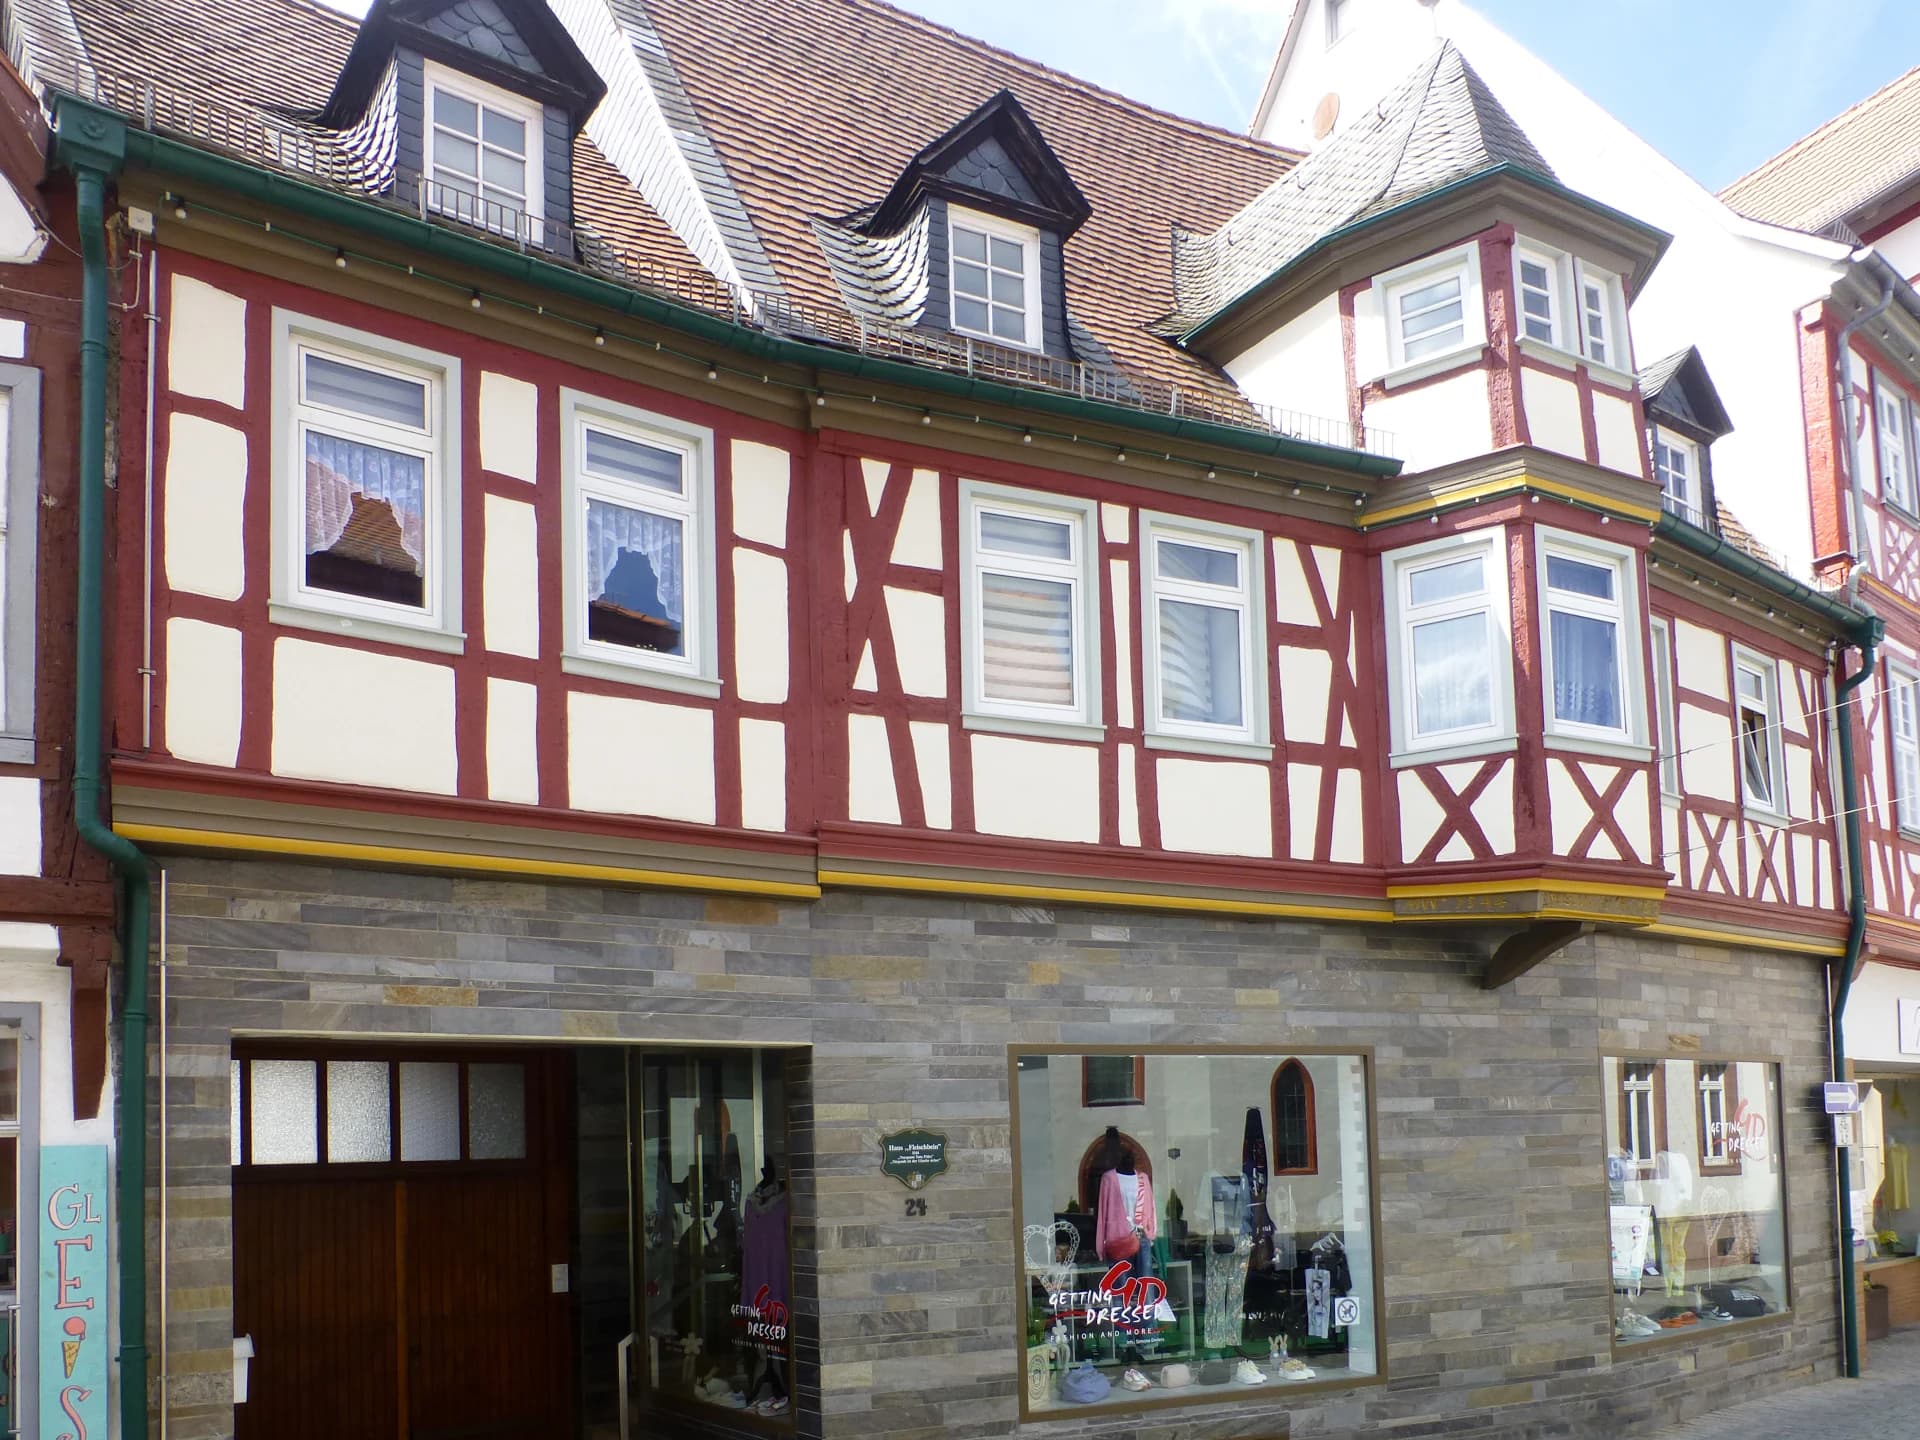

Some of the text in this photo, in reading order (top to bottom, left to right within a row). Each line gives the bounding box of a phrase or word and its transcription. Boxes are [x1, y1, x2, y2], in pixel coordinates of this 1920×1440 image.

[905, 1198, 927, 1216] 24
[1049, 1290, 1112, 1309] GETTING
[731, 1304, 760, 1319] GETTING
[747, 1321, 786, 1340] DRESSED
[1050, 1332, 1094, 1342] FSHION
